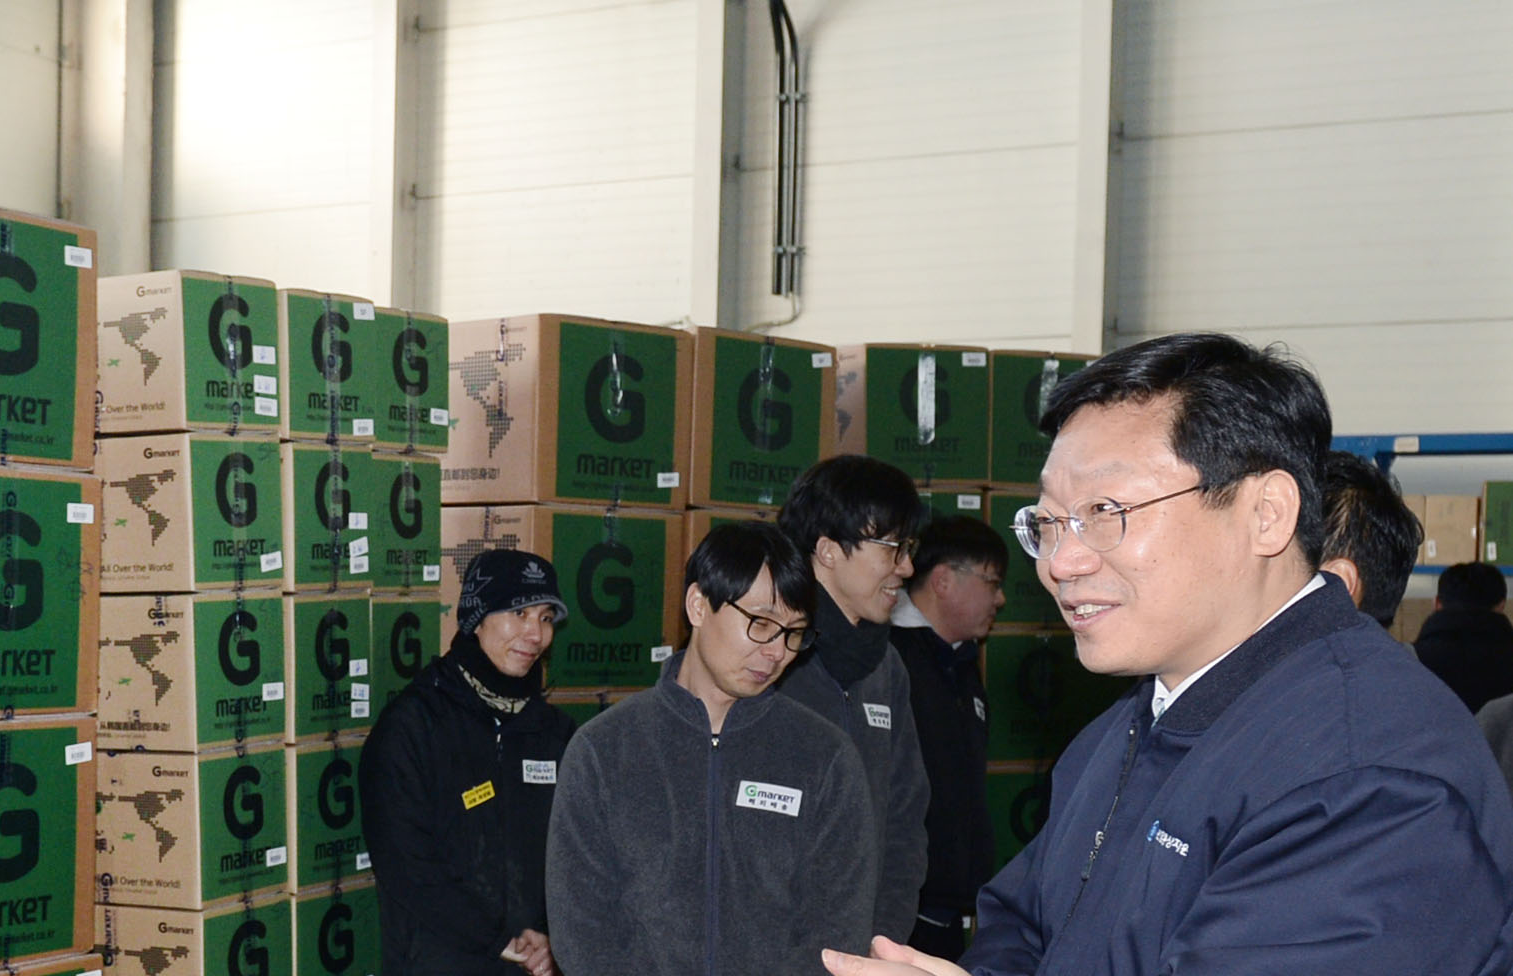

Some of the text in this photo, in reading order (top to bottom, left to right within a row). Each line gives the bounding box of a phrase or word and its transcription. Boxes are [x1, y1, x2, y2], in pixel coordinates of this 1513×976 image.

[209, 294, 253, 370] G
[312, 311, 352, 383] G
[393, 328, 428, 396] G
[206, 380, 254, 398] marke
[389, 405, 430, 422] marke
[585, 352, 646, 443] G
[738, 367, 792, 450] G
[144, 448, 180, 459] Gmarket
[577, 454, 655, 478] market
[215, 452, 257, 527] G
[314, 461, 350, 531] G
[390, 473, 422, 539] G
[113, 563, 131, 573] Over
[133, 563, 146, 572] the
[148, 562, 174, 572] World!
[312, 541, 350, 559] marke
[578, 542, 634, 629] G
[218, 611, 260, 686] G
[315, 609, 351, 682] G
[391, 612, 422, 679] G
[567, 643, 642, 662] market
[312, 694, 351, 711] marke
[153, 767, 189, 777] Gmarket
[224, 766, 264, 840] G
[318, 759, 354, 829] G
[745, 784, 795, 803] Gmarket
[140, 878, 153, 887] the
[155, 879, 181, 889] World!
[221, 847, 271, 872] marke
[159, 923, 193, 934] Gmarket
[319, 904, 355, 974] G
